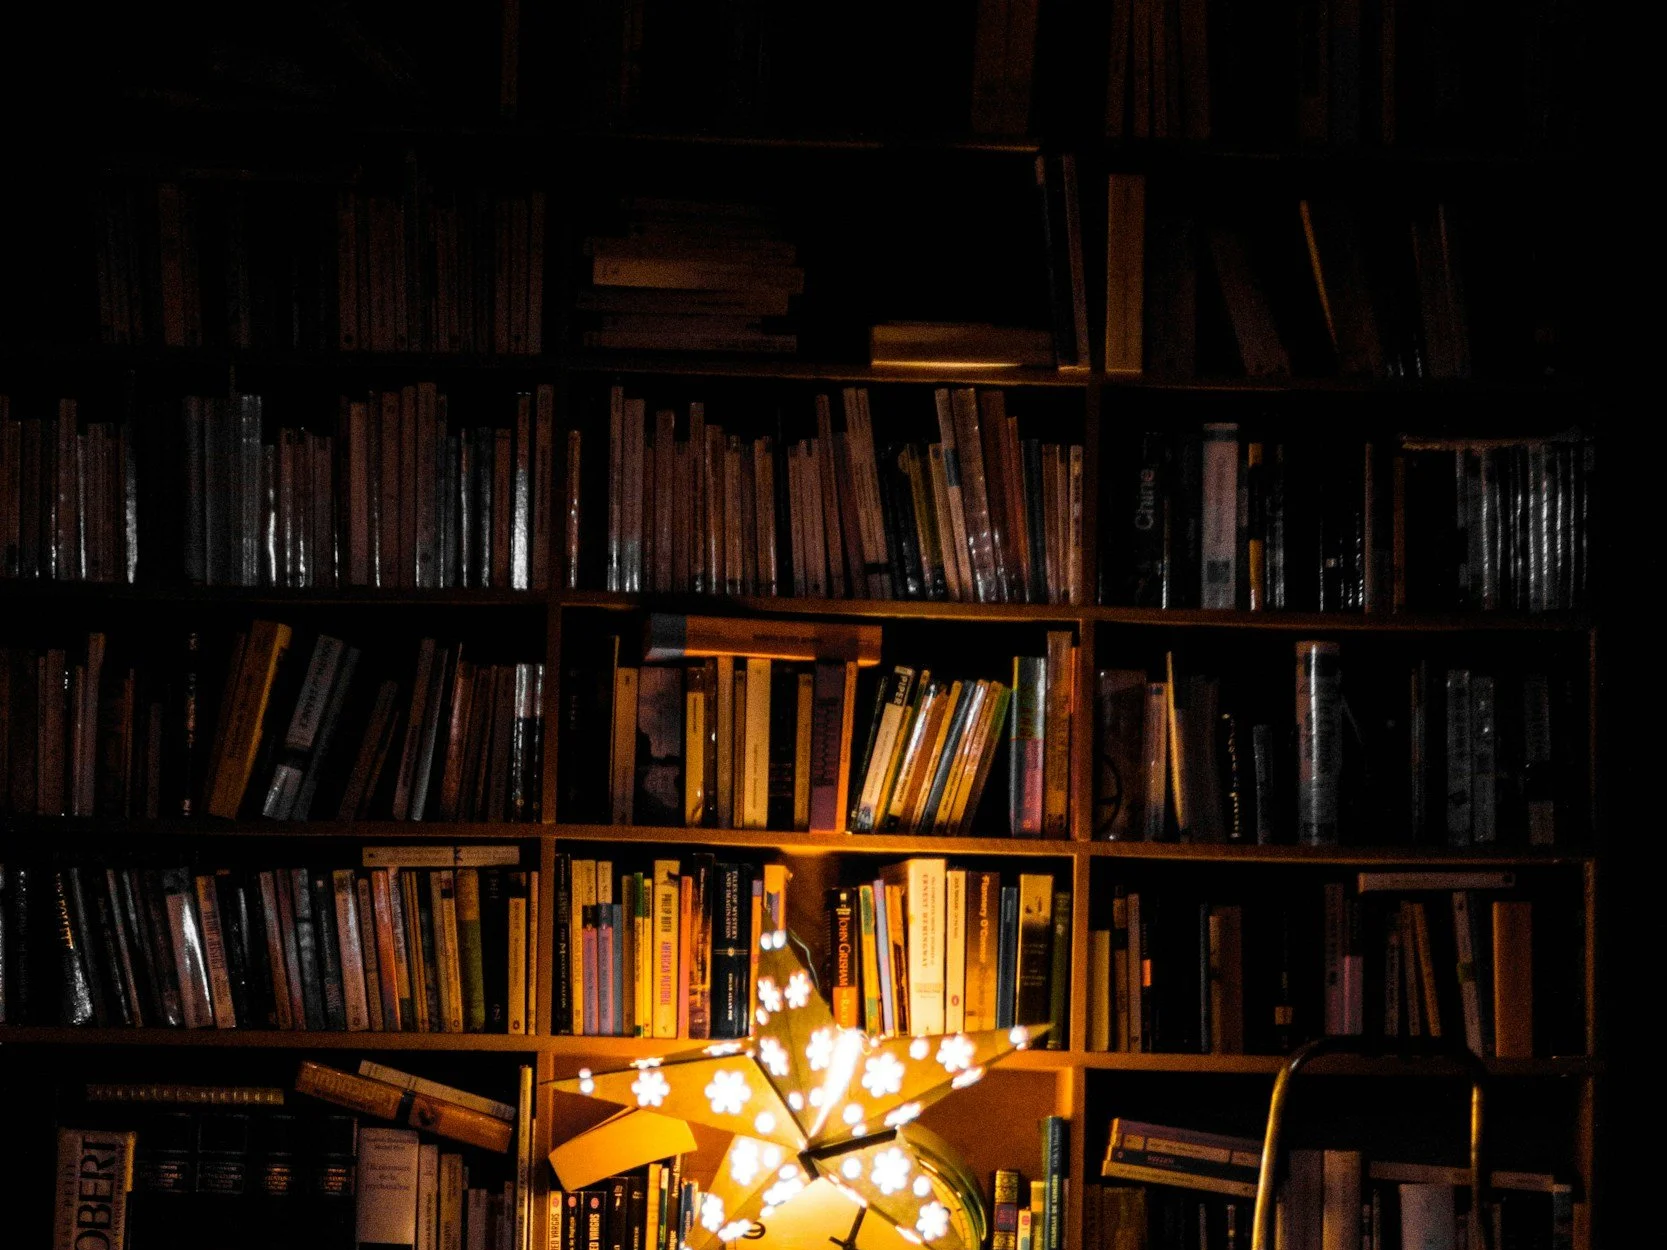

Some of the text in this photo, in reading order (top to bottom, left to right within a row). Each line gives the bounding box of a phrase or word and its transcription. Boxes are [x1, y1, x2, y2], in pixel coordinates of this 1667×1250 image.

[1134, 469, 1154, 530] Chine
[894, 675, 909, 705] PIPER
[661, 894, 672, 932] PHILIP ROTH
[731, 894, 738, 904] OF
[979, 876, 990, 963] Flannery O'Connor
[838, 917, 852, 987] JOHN GRISHAM
[661, 941, 672, 1005] AMERICAN PASTORAL
[64, 1161, 75, 1207] PETIT
[671, 1173, 680, 1198] Arnaud
[114, 1199, 123, 1237] LANGUE
[550, 1213, 559, 1238] VARGAS
[588, 1213, 599, 1240] VARGAS
